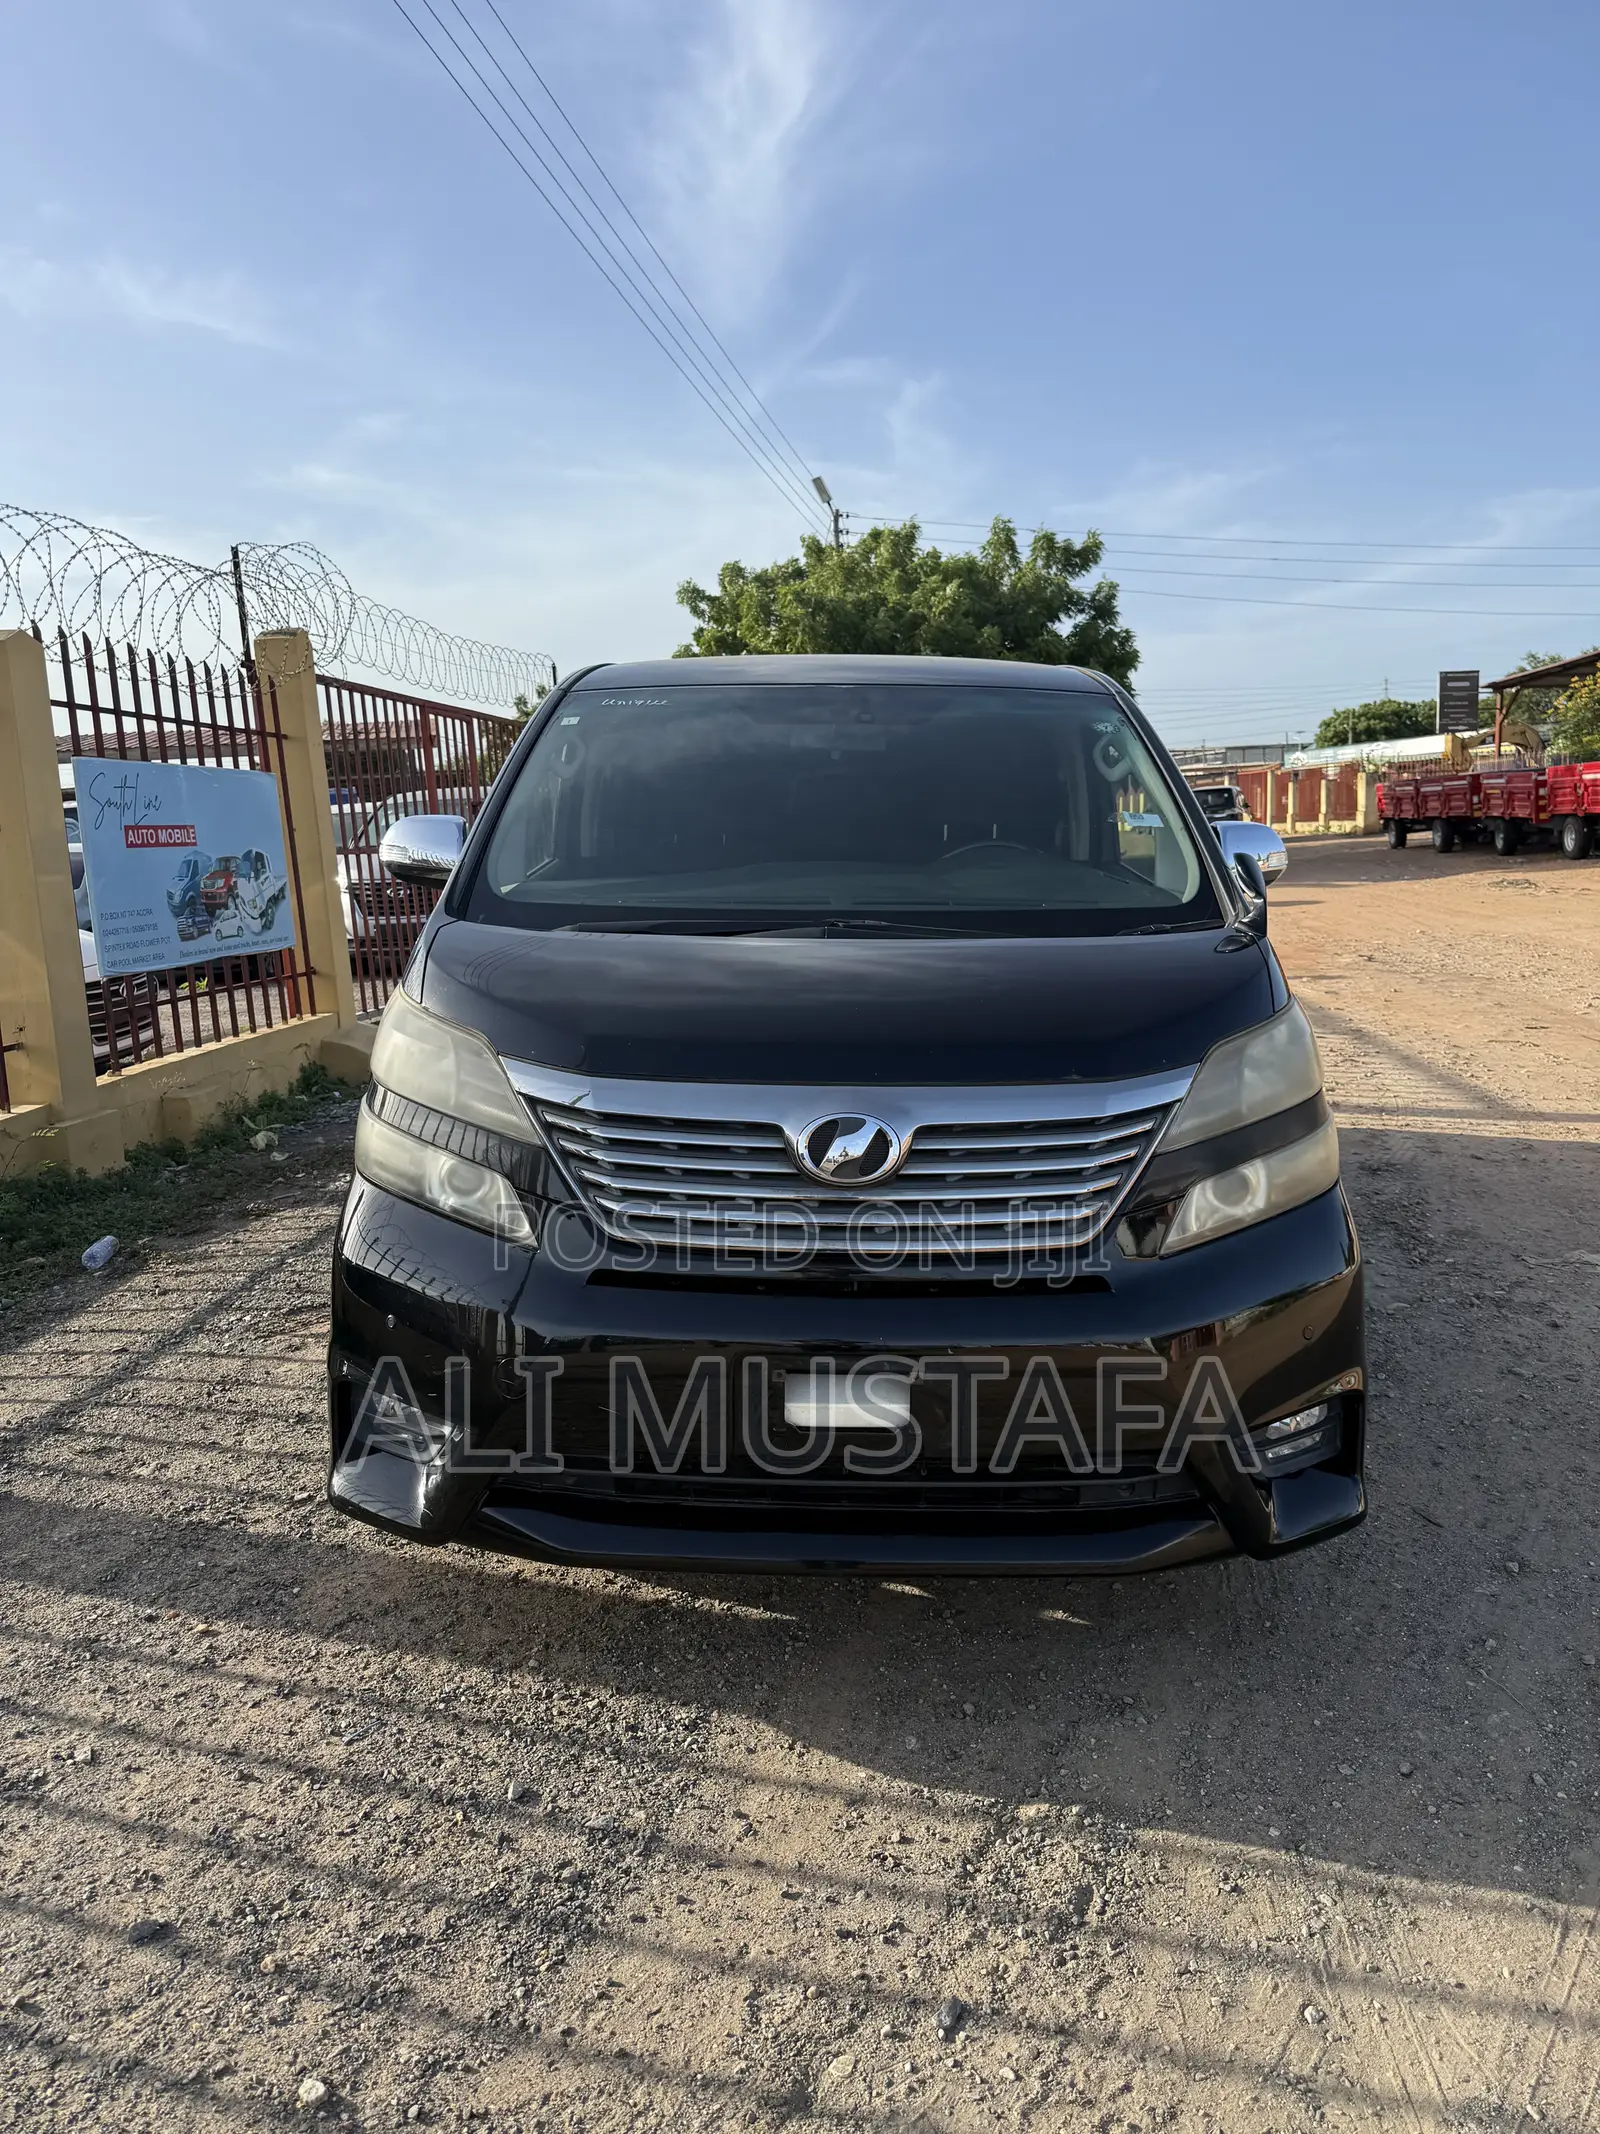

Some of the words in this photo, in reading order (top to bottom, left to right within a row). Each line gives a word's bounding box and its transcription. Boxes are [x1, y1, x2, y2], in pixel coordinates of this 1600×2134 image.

[126, 828, 157, 846] AUTO
[157, 827, 197, 845] MOBILE
[104, 943, 126, 953] SPINTEX
[126, 940, 140, 950] ROAD
[140, 937, 161, 948] FLOWER
[106, 959, 118, 969] CAR
[118, 957, 132, 967] POOL
[132, 954, 152, 965] MARKET
[152, 952, 166, 961] AREA
